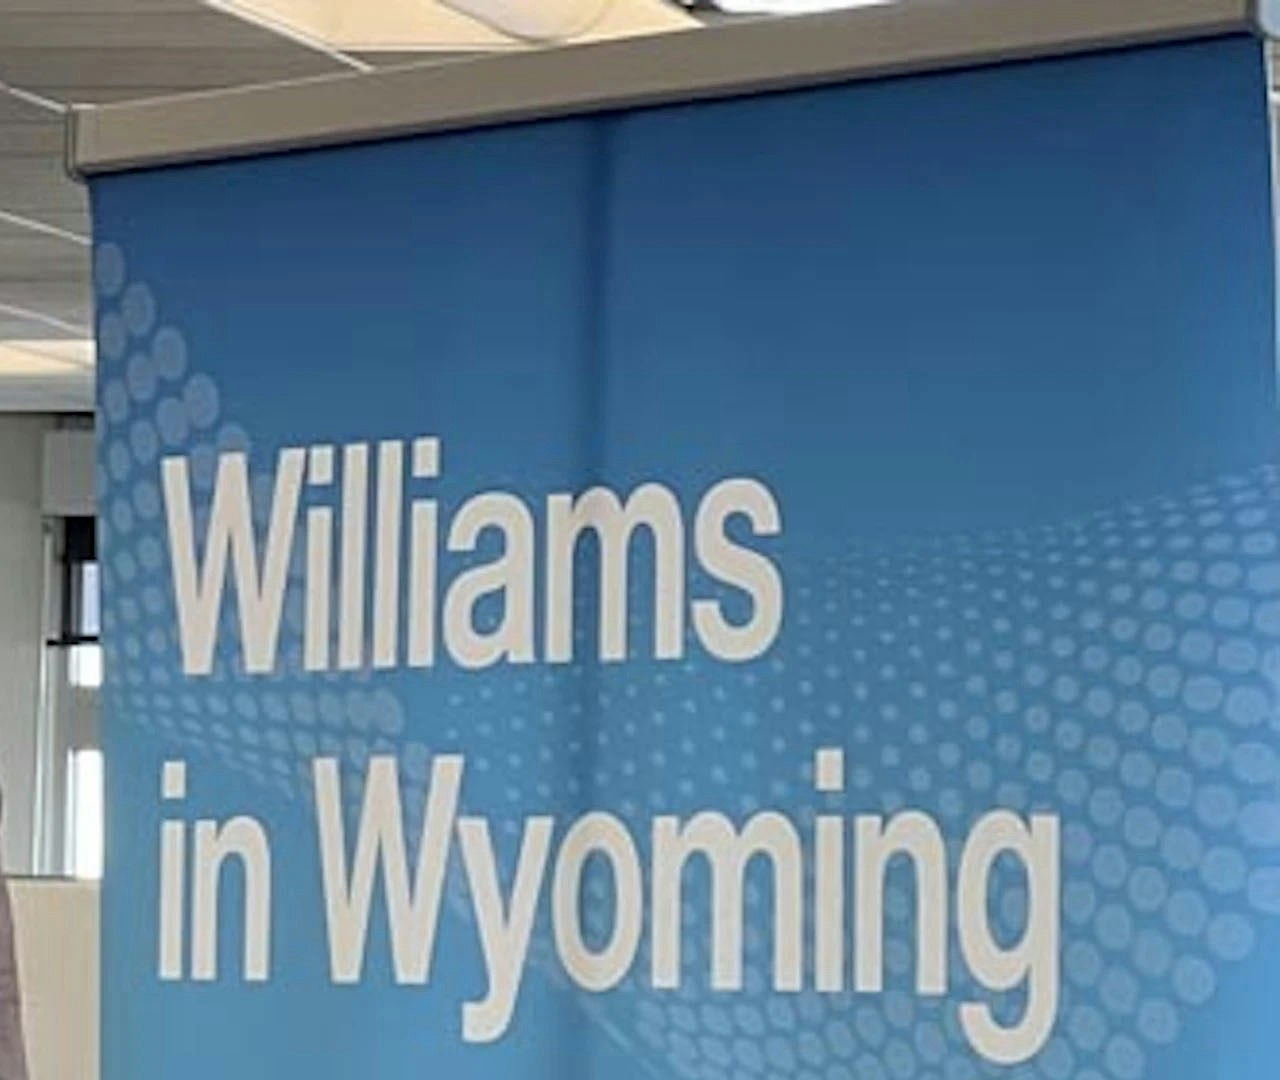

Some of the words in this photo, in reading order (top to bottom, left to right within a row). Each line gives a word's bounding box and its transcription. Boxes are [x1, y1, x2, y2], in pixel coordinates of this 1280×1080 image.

[160, 437, 783, 676] Williams
[157, 760, 272, 982] in
[312, 748, 1061, 1066] Wyoming
